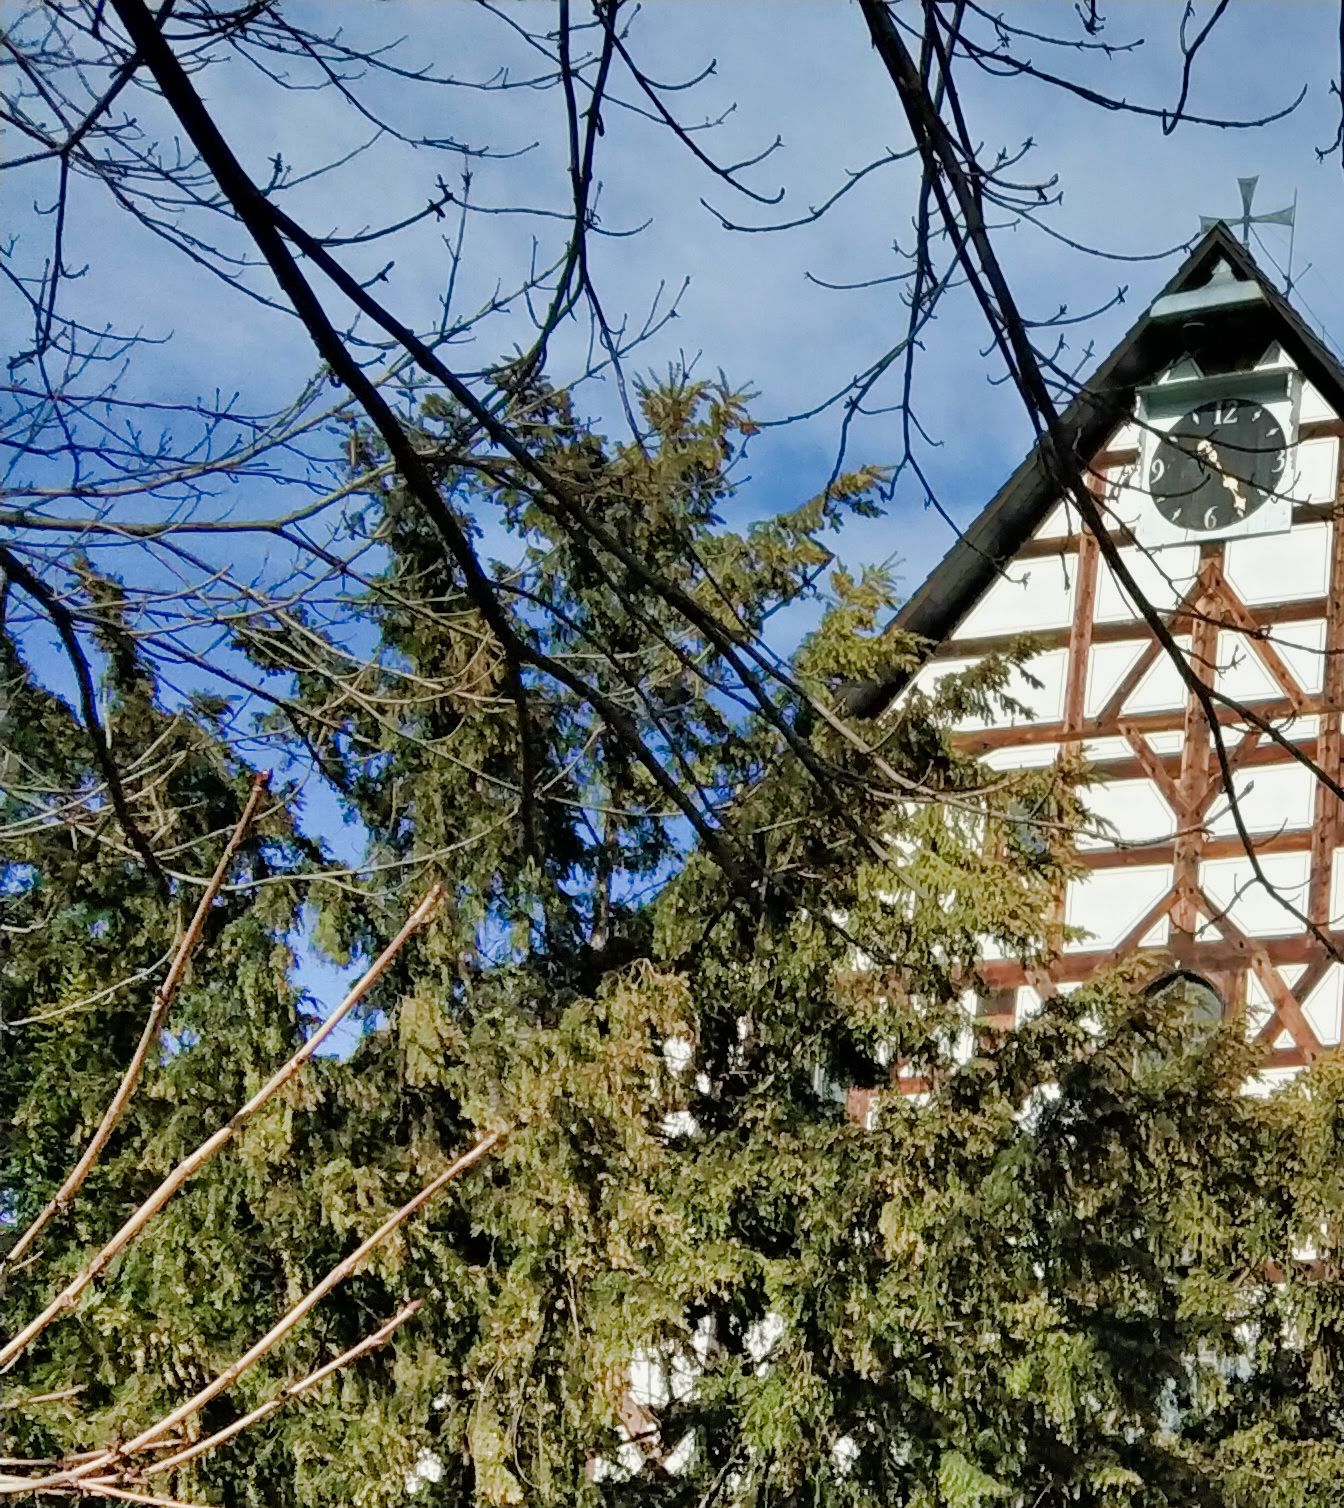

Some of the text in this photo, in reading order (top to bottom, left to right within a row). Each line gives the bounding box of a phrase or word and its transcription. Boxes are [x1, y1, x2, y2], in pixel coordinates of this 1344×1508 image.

[1213, 402, 1238, 425] 12
[1150, 459, 1165, 484] 9
[1271, 451, 1285, 473] 3
[1204, 505, 1219, 530] 6
